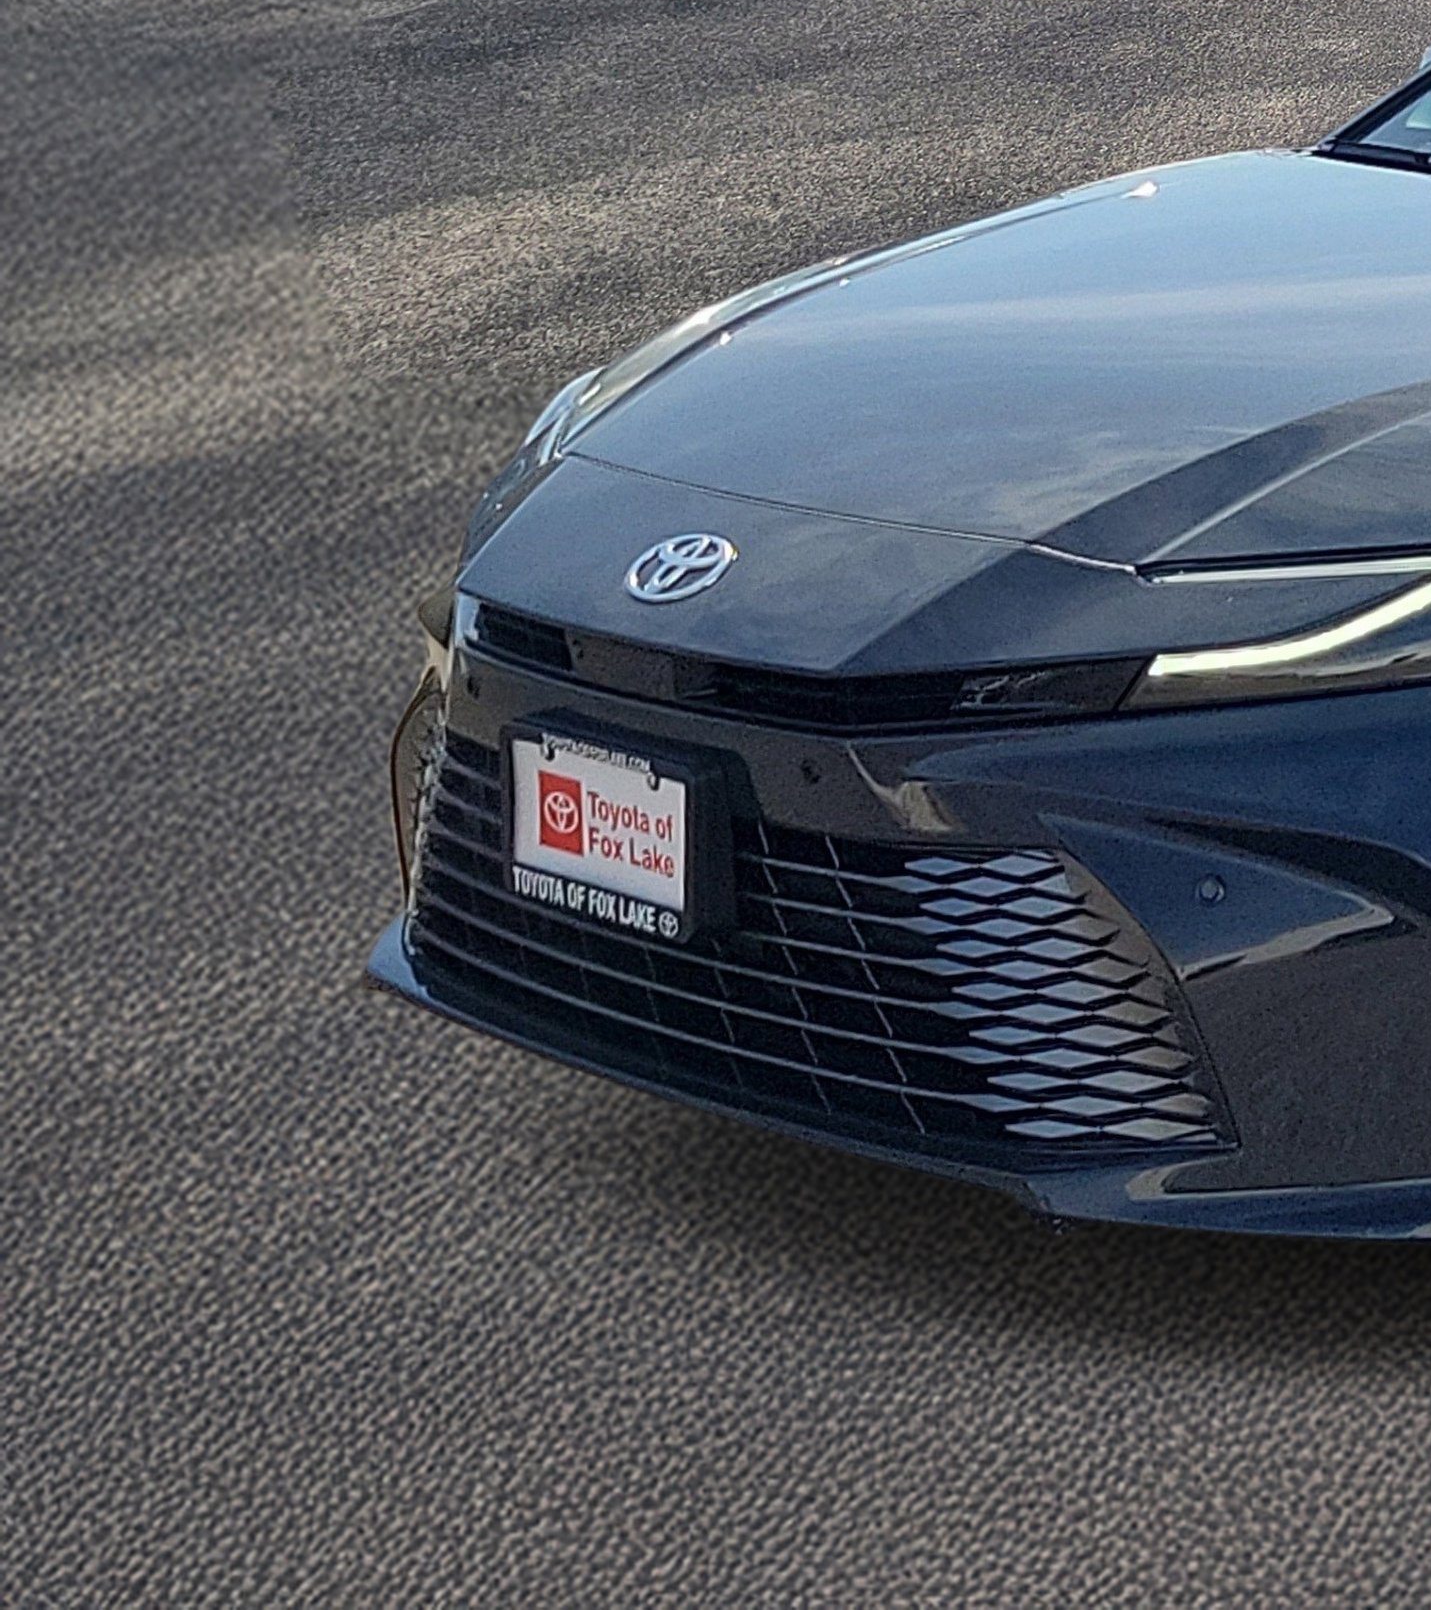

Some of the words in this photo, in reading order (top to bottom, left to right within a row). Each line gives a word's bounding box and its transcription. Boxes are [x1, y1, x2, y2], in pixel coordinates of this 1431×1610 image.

[587, 791, 650, 834] Toyota
[656, 814, 673, 842] of
[588, 828, 625, 861] Fox
[629, 837, 675, 878] Lake
[512, 866, 565, 907] TOYOTA
[567, 884, 586, 911] OF
[588, 889, 616, 922] FOX
[619, 897, 656, 931] LAKE
